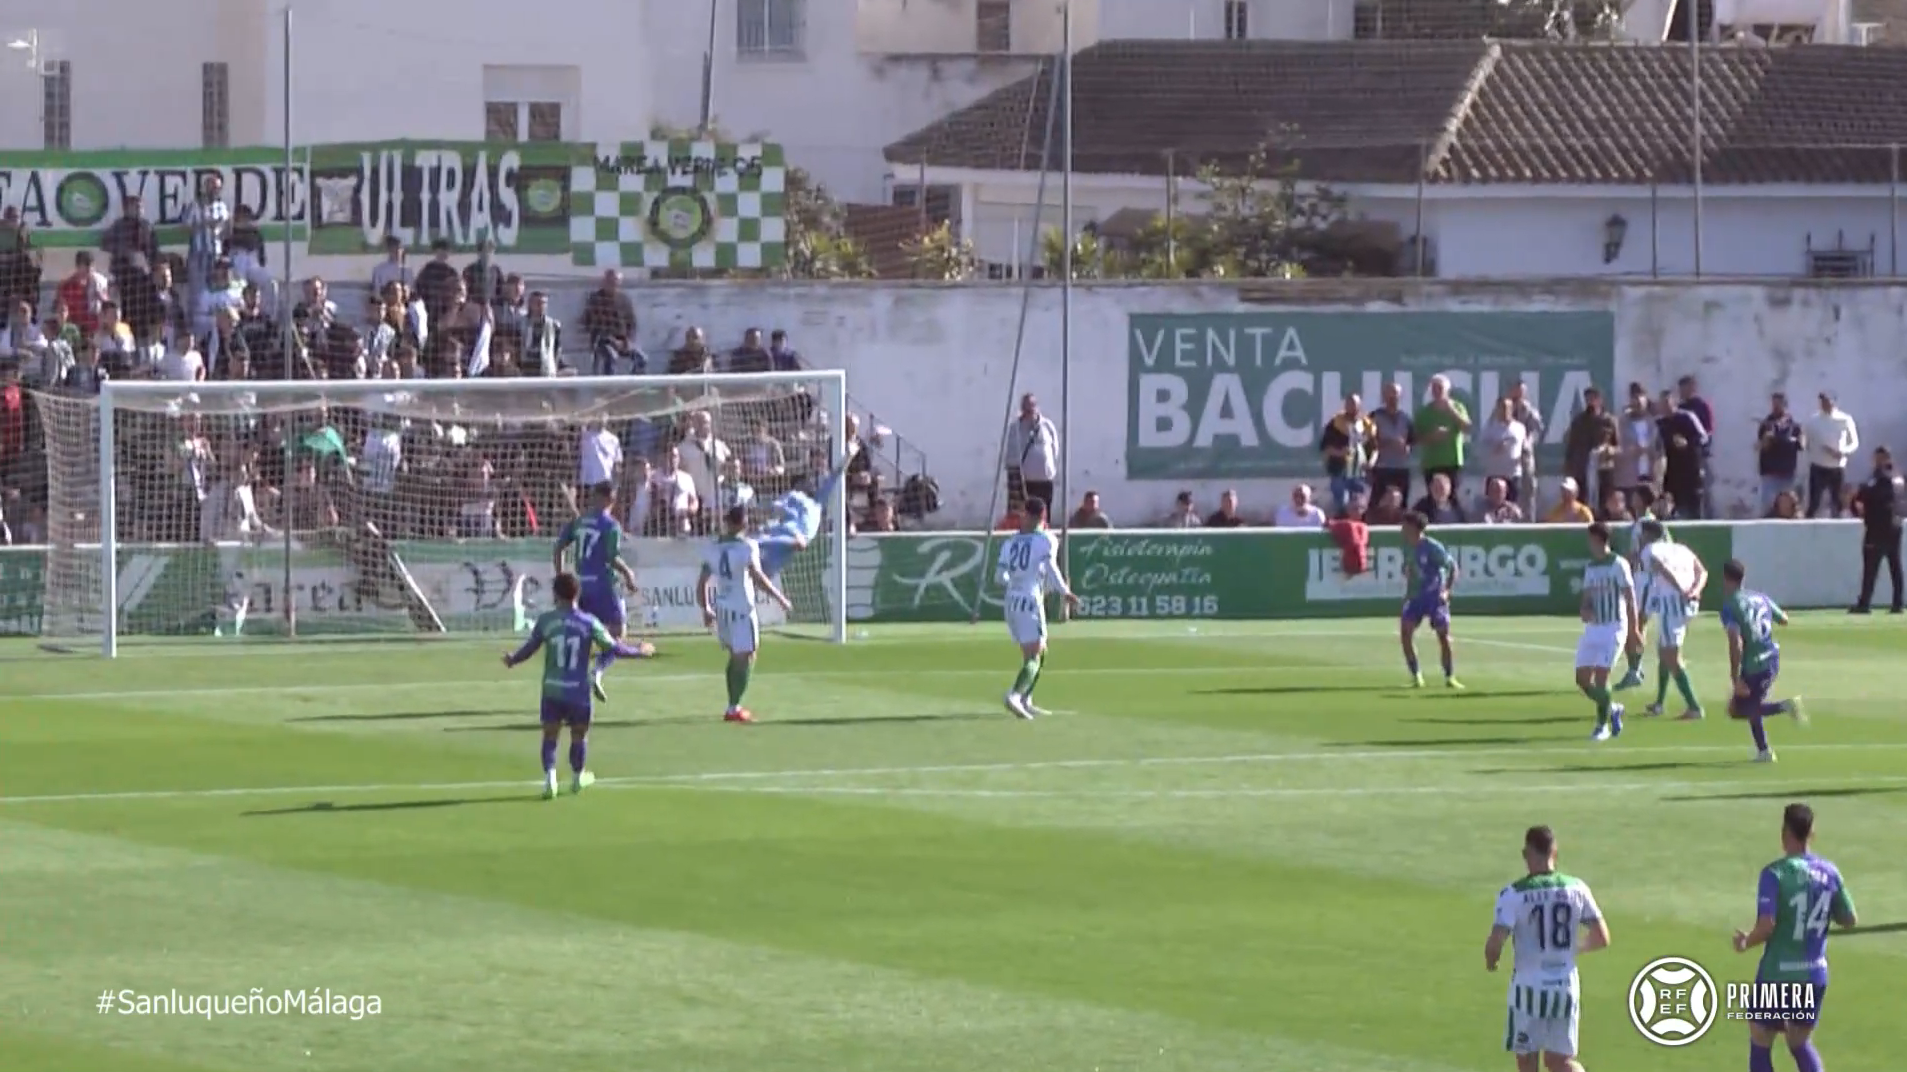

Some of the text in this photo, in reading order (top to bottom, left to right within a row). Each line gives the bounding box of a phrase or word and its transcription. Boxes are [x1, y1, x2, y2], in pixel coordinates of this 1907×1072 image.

[361, 149, 522, 247] ULTRAS
[1134, 327, 1308, 368] VENTA
[575, 527, 601, 559] 17
[1009, 540, 1031, 571] 20
[719, 549, 733, 580] 4
[1077, 595, 1219, 616] 623 11 58 16
[551, 634, 581, 671] 11
[1530, 903, 1573, 950] 18
[1788, 889, 1834, 941] 14
